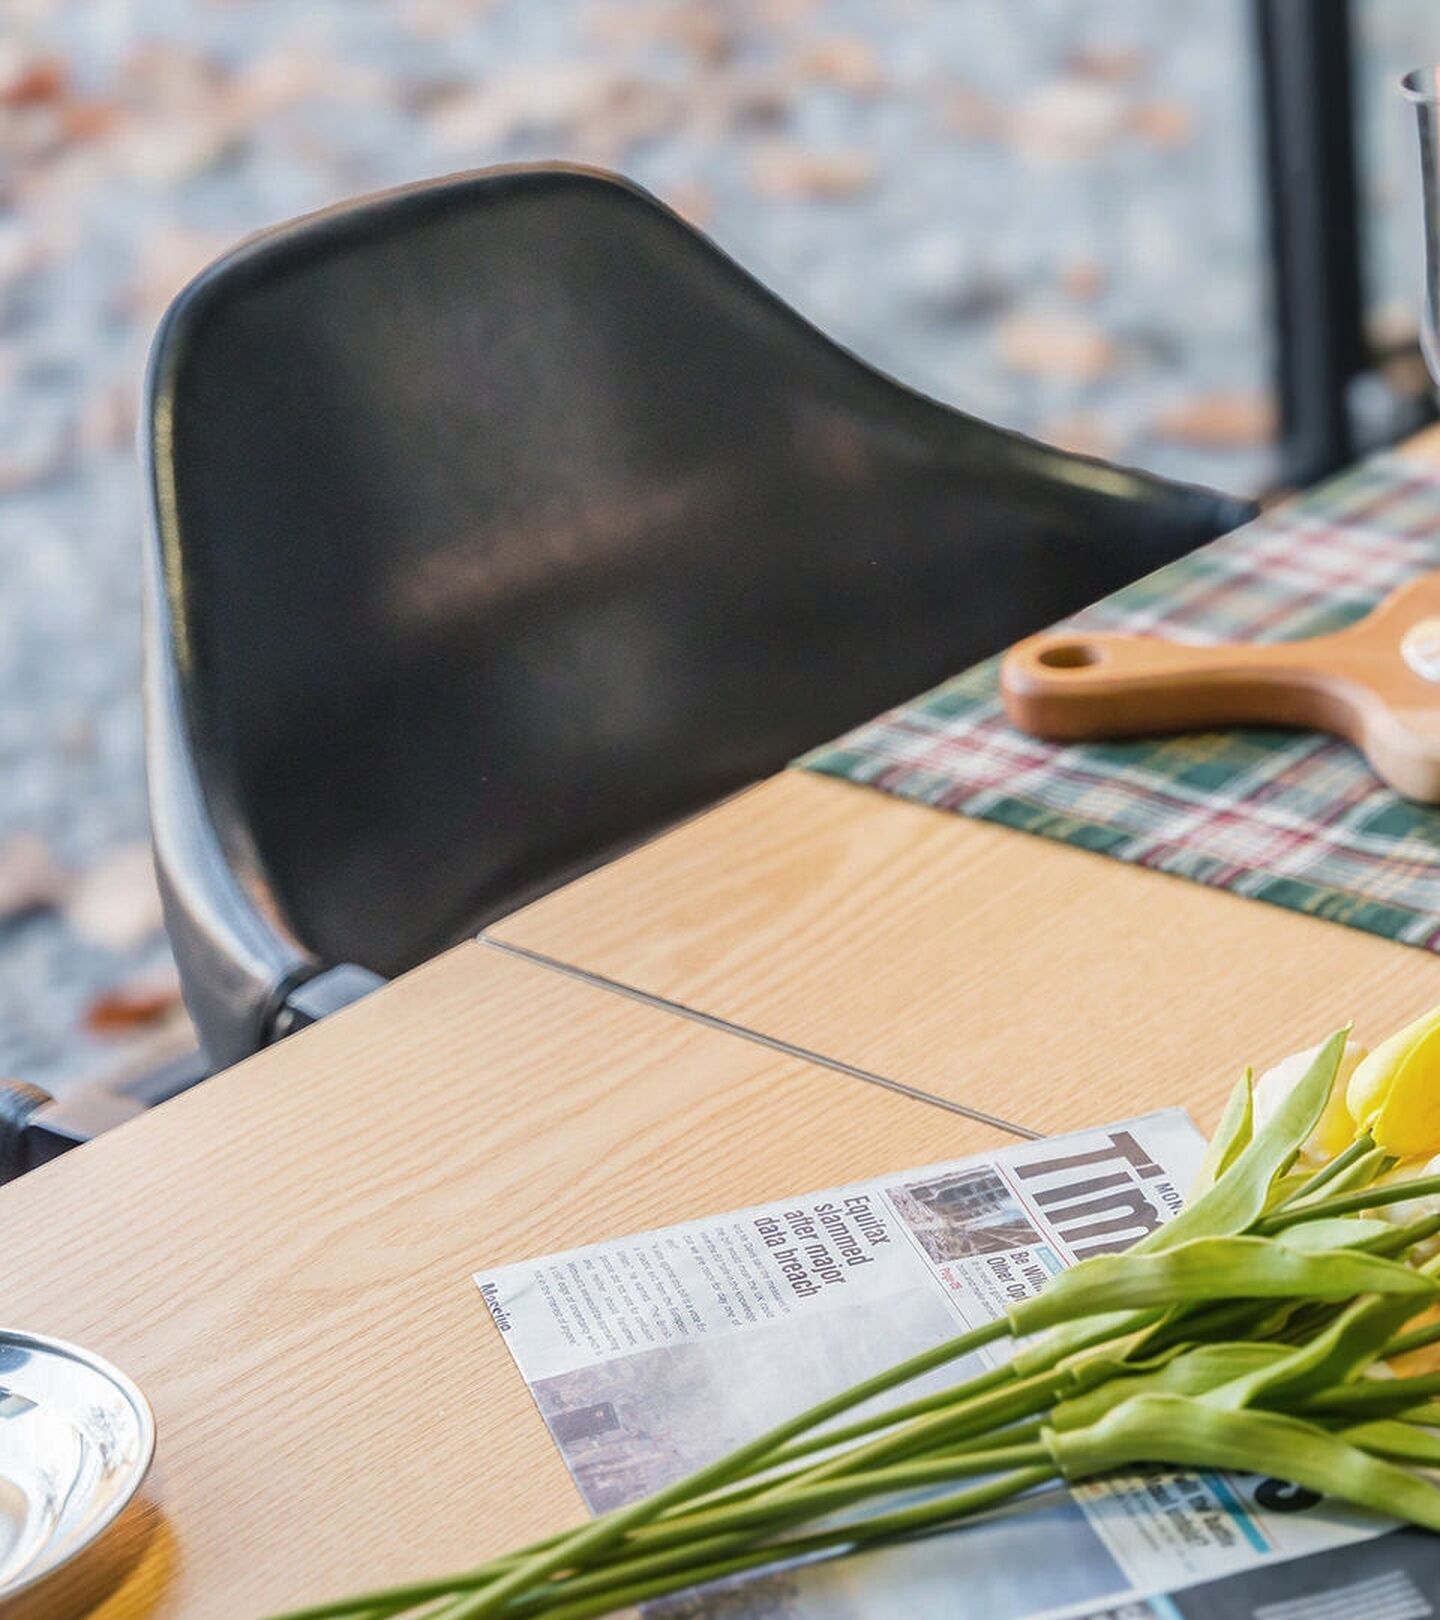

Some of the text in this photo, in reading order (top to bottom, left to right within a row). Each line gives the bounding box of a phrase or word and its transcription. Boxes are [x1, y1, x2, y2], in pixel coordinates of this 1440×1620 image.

[843, 1195, 891, 1247] Equifax
[1014, 1131, 1165, 1262] Tim
[1154, 1183, 1183, 1215] MON
[753, 1216, 787, 1247] data
[773, 1247, 822, 1298] breach
[783, 1210, 847, 1284] after major
[813, 1203, 875, 1267] slammed
[1010, 1251, 1029, 1265] Be
[986, 1257, 1015, 1282] Other
